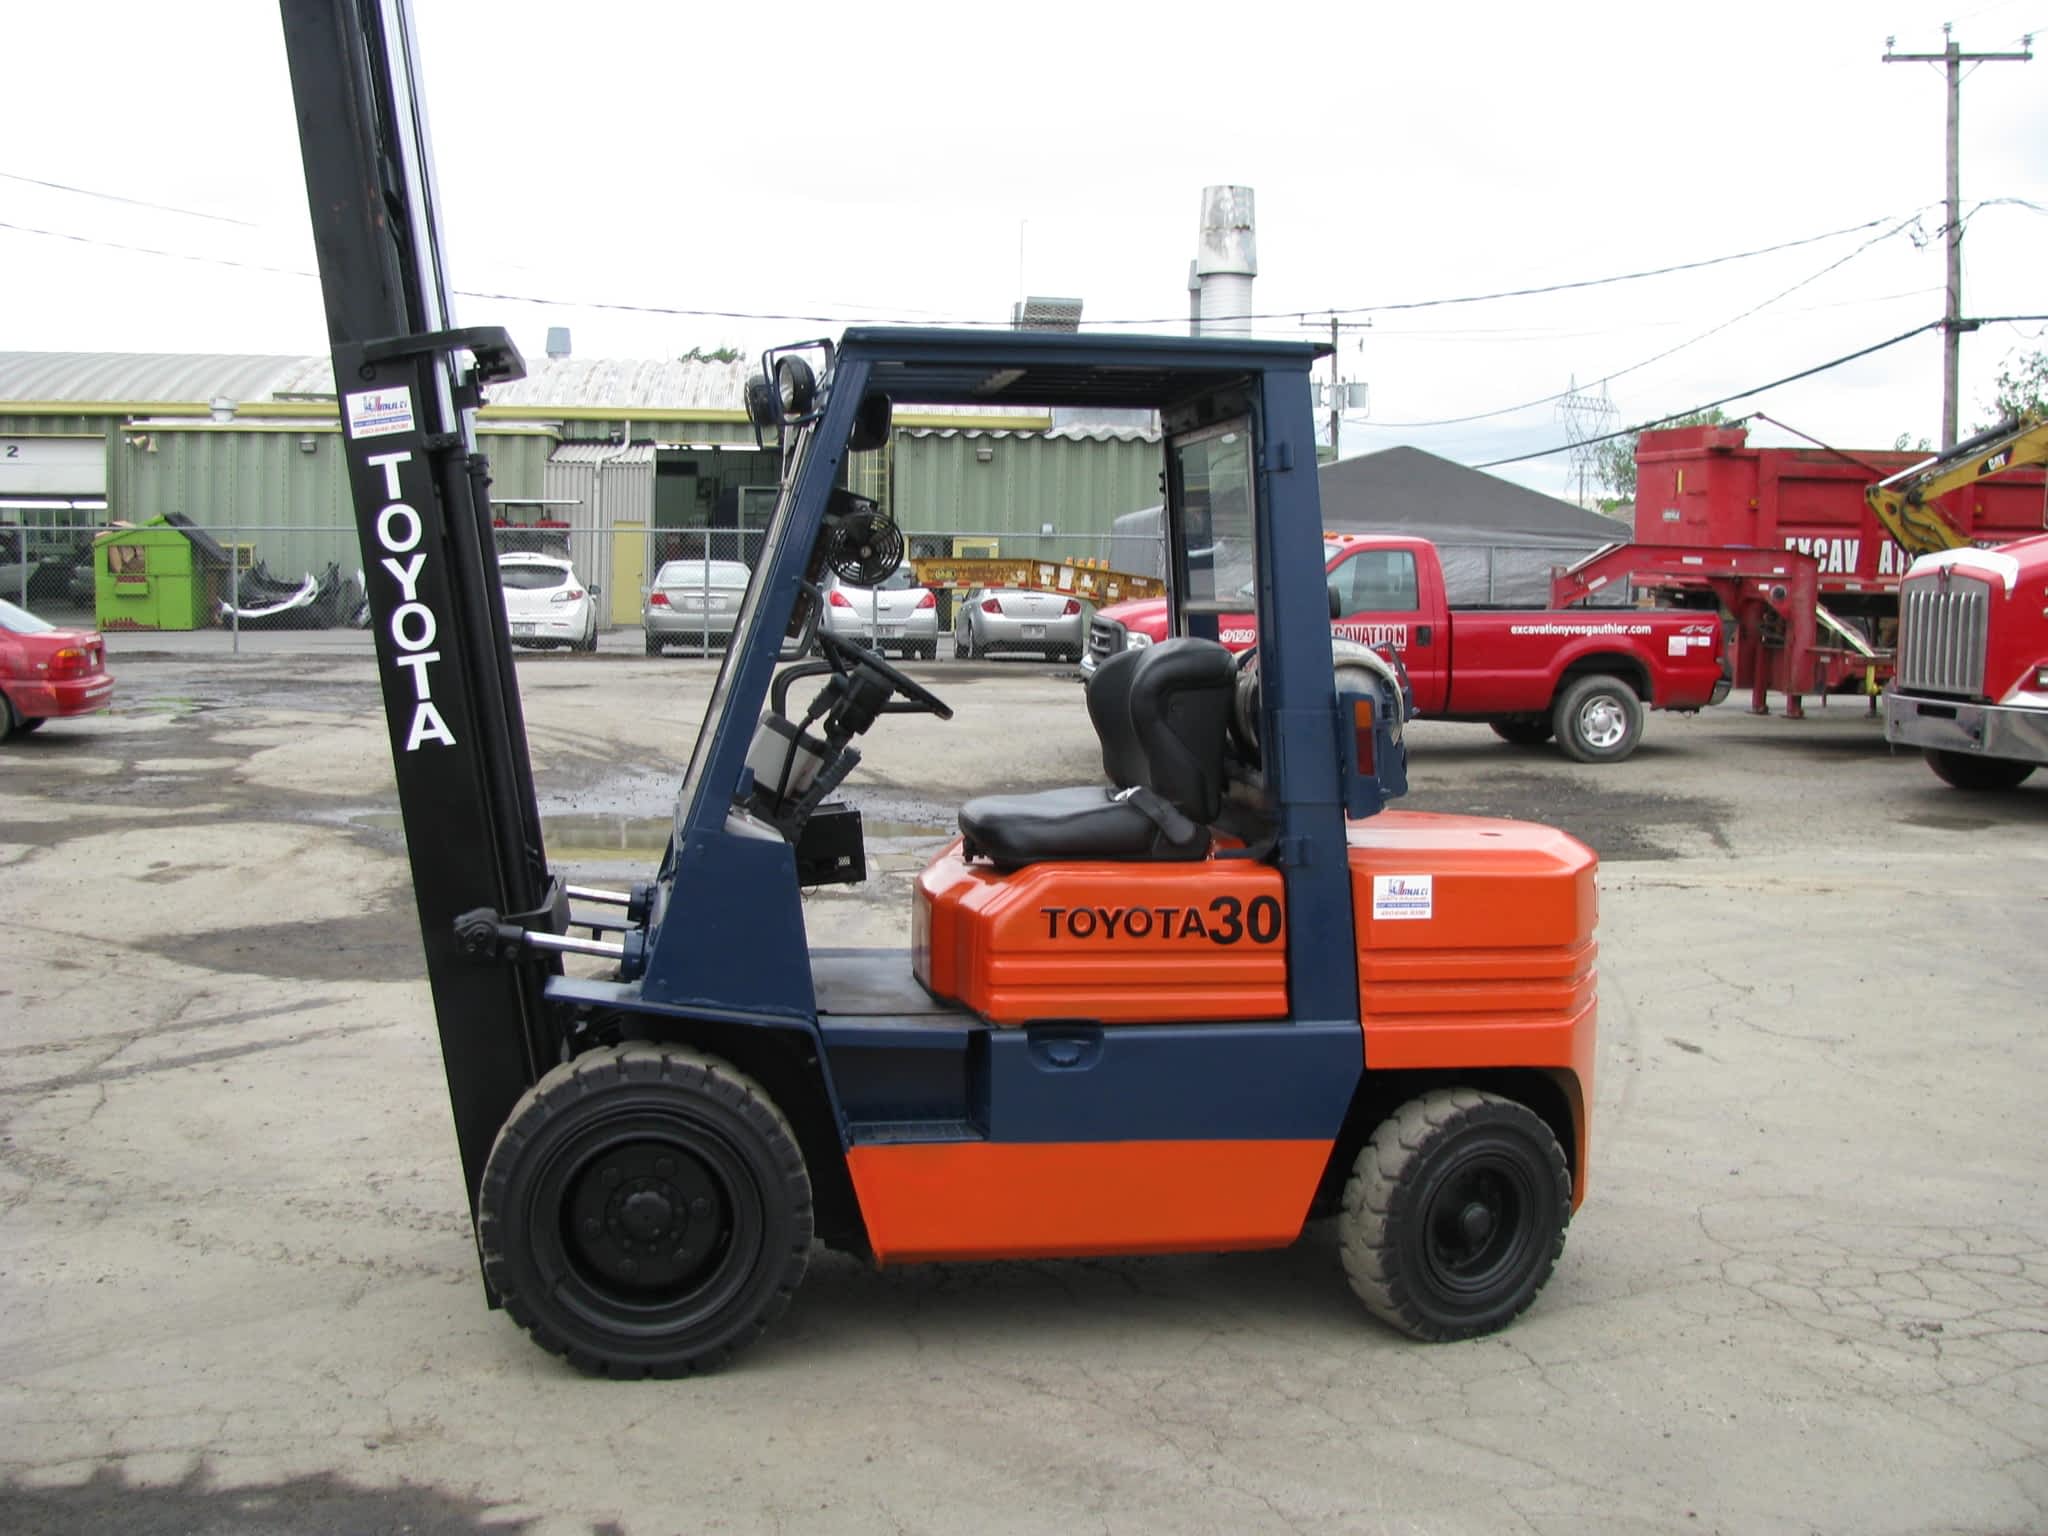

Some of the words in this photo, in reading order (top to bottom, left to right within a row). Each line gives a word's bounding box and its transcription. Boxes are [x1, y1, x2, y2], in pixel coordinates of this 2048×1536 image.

[6, 444, 19, 458] 2
[1987, 453, 2006, 471] CAT
[367, 451, 456, 751] TOYOTA
[1510, 623, 1652, 637] excavationyvesgauthier.com
[1040, 907, 1208, 939] TOYOTA
[1208, 895, 1283, 945] 30
